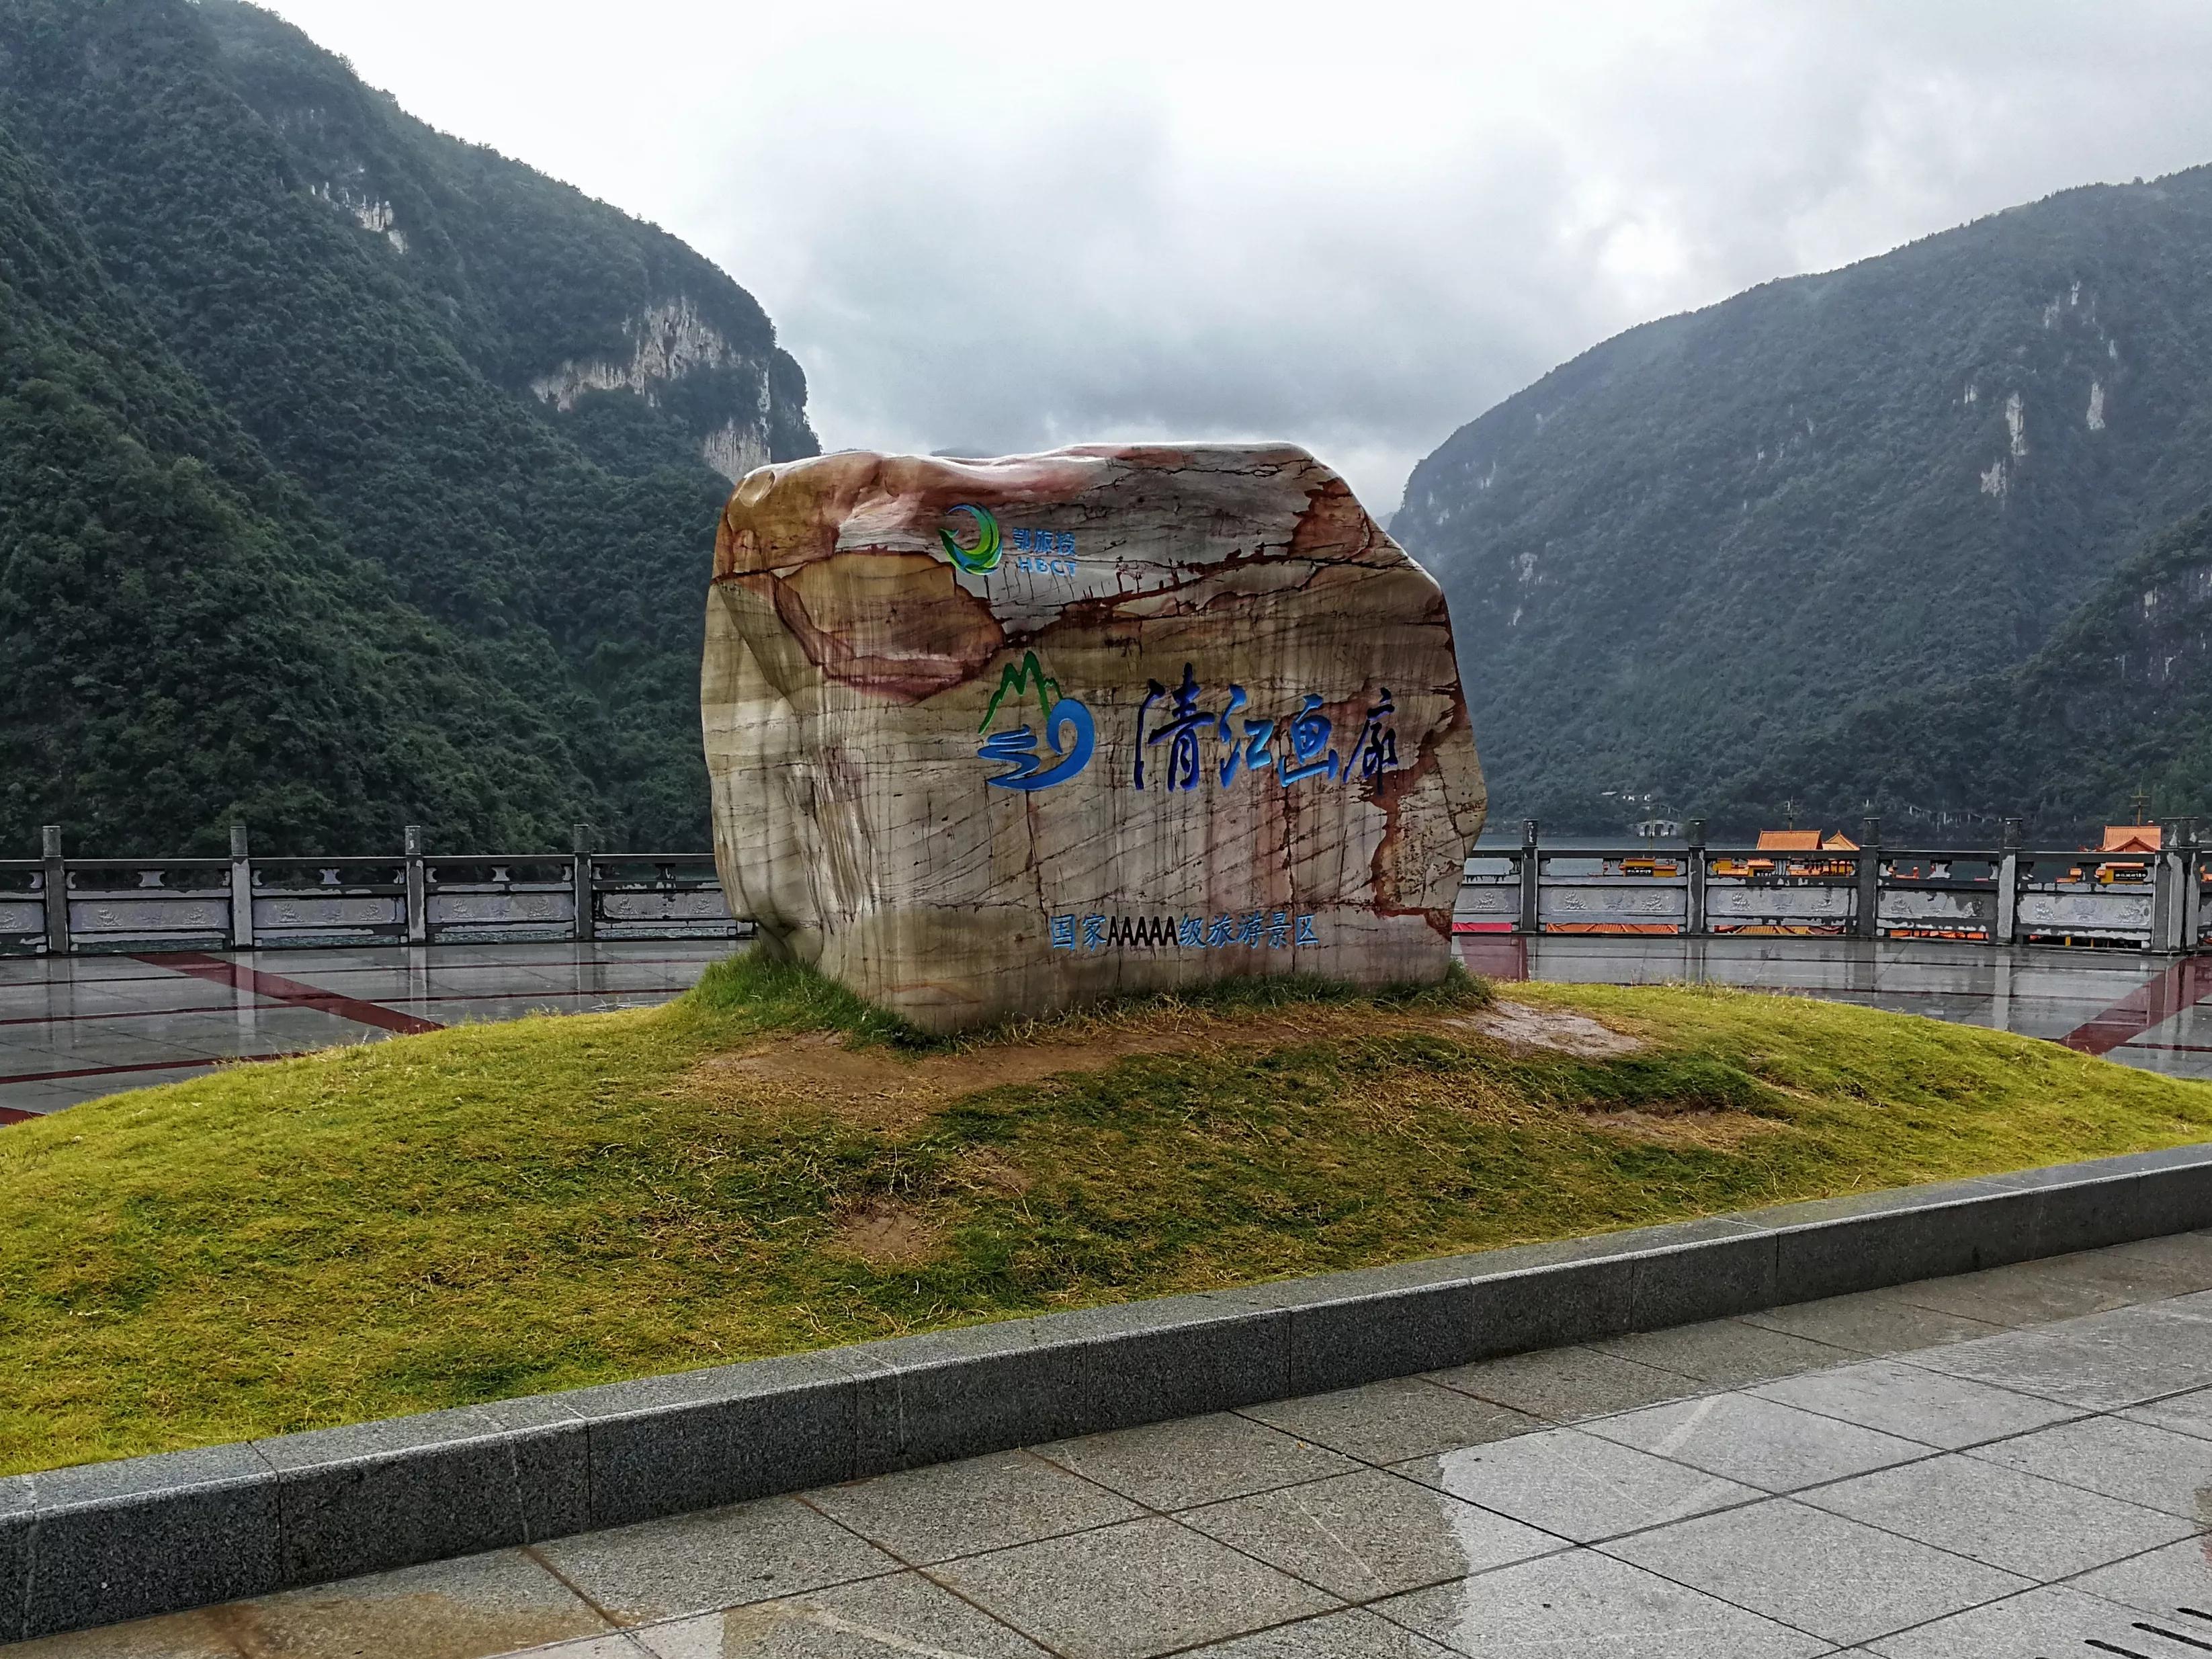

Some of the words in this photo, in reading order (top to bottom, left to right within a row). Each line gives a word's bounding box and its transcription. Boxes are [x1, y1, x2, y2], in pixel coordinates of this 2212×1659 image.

[1013, 527, 1076, 556] 鄂旅投
[1018, 556, 1076, 577] HBCT
[1134, 663, 1398, 794] 清江画廊
[1050, 910, 1320, 951] 国家AAAAA级旅游景区
